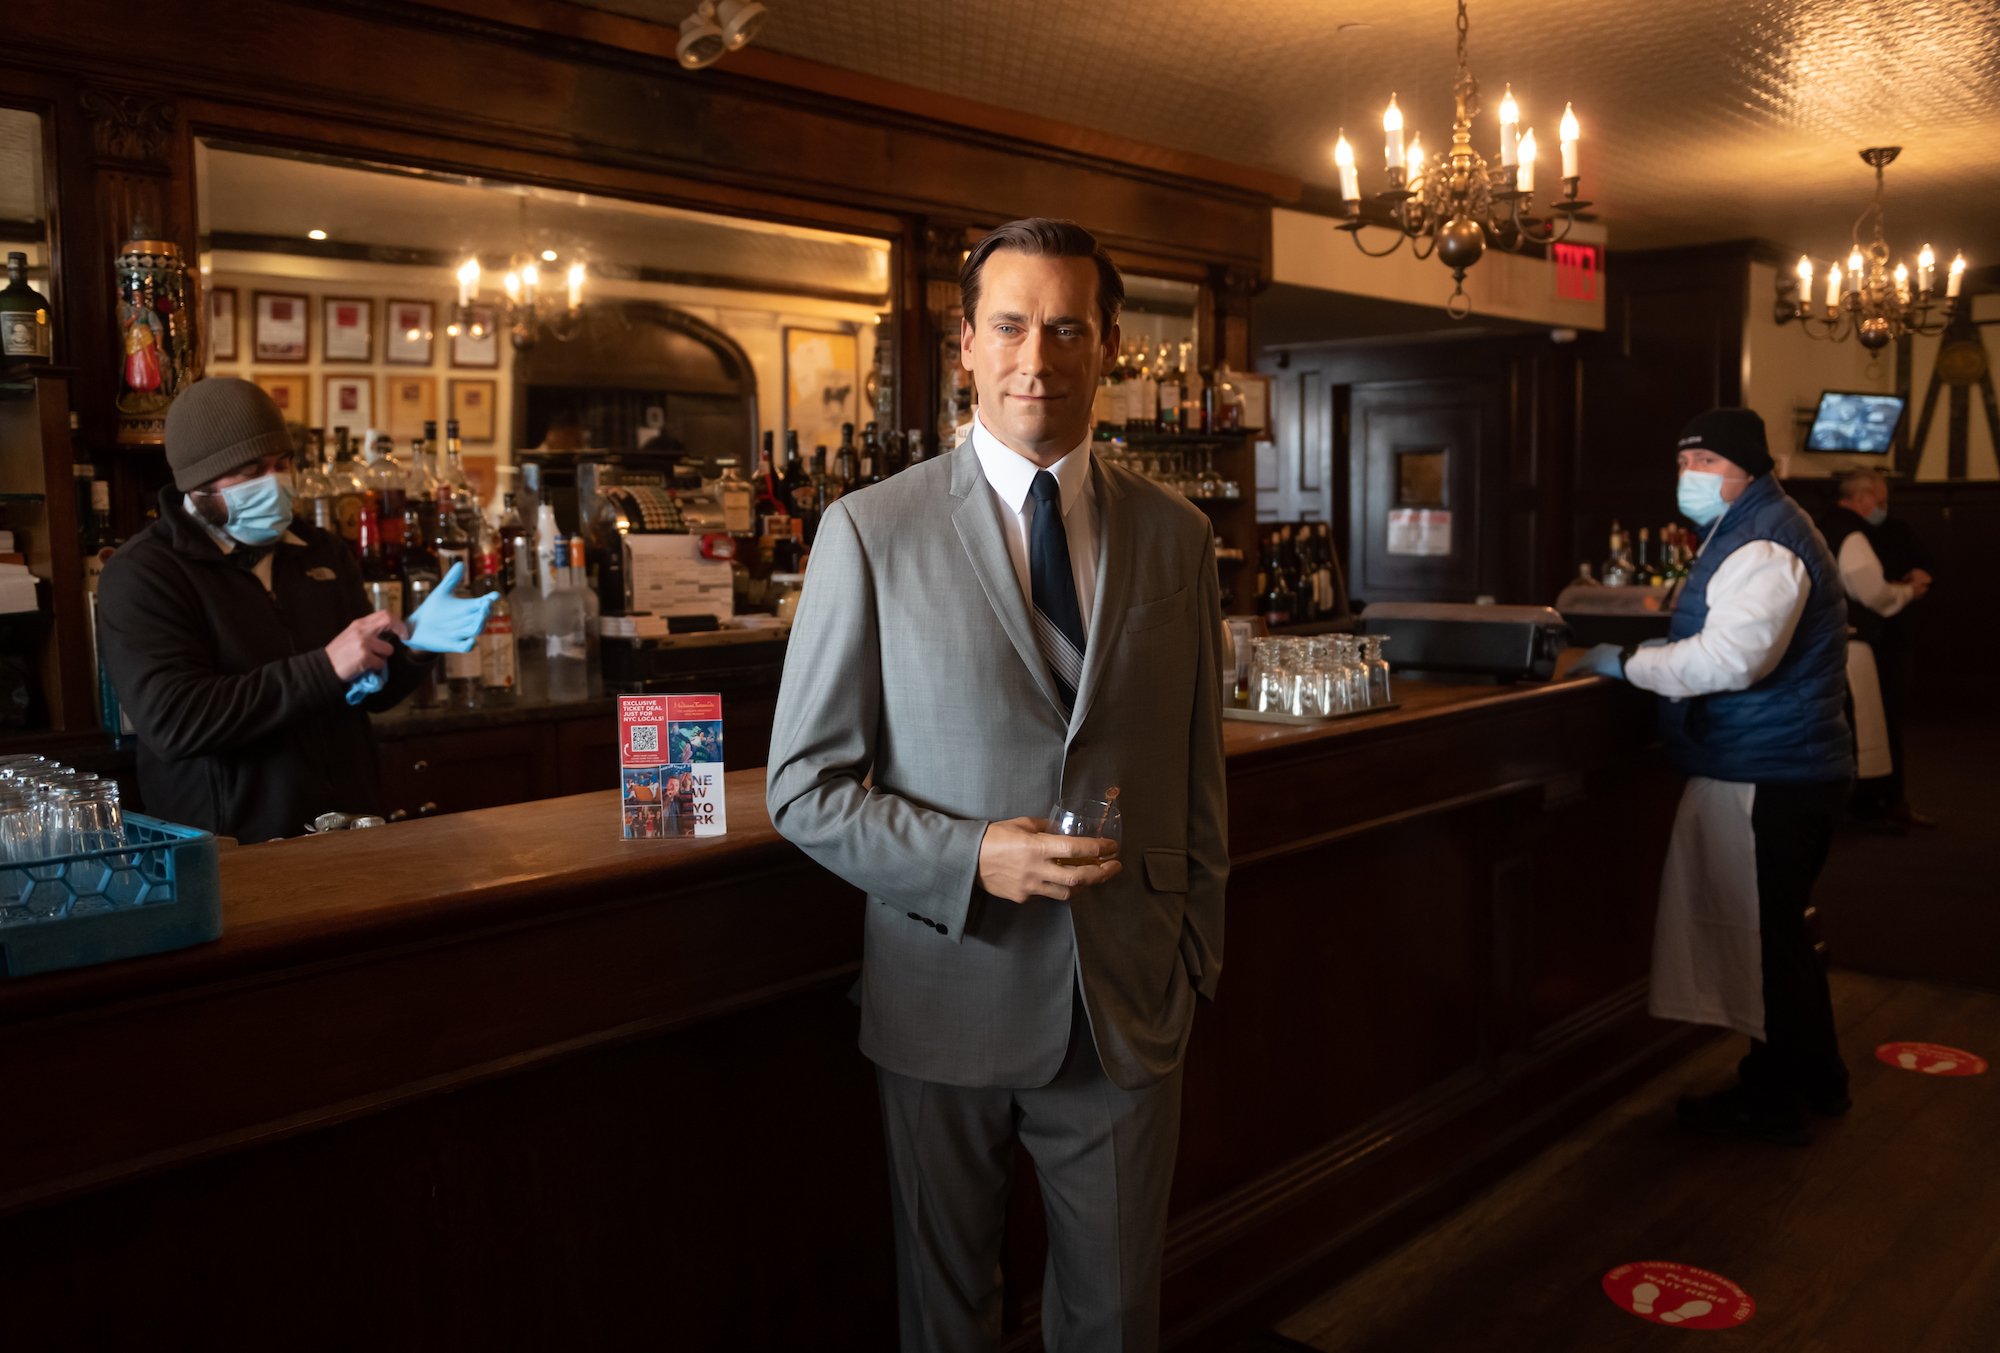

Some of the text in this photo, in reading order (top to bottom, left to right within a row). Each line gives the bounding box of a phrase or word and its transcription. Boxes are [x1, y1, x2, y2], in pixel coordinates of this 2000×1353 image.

[692, 775, 713, 786] NE
[693, 802, 714, 814] YO
[695, 815, 714, 825] RK
[1665, 1272, 1718, 1292] PLEASE
[1643, 1273, 1728, 1305] WAIT HERE
